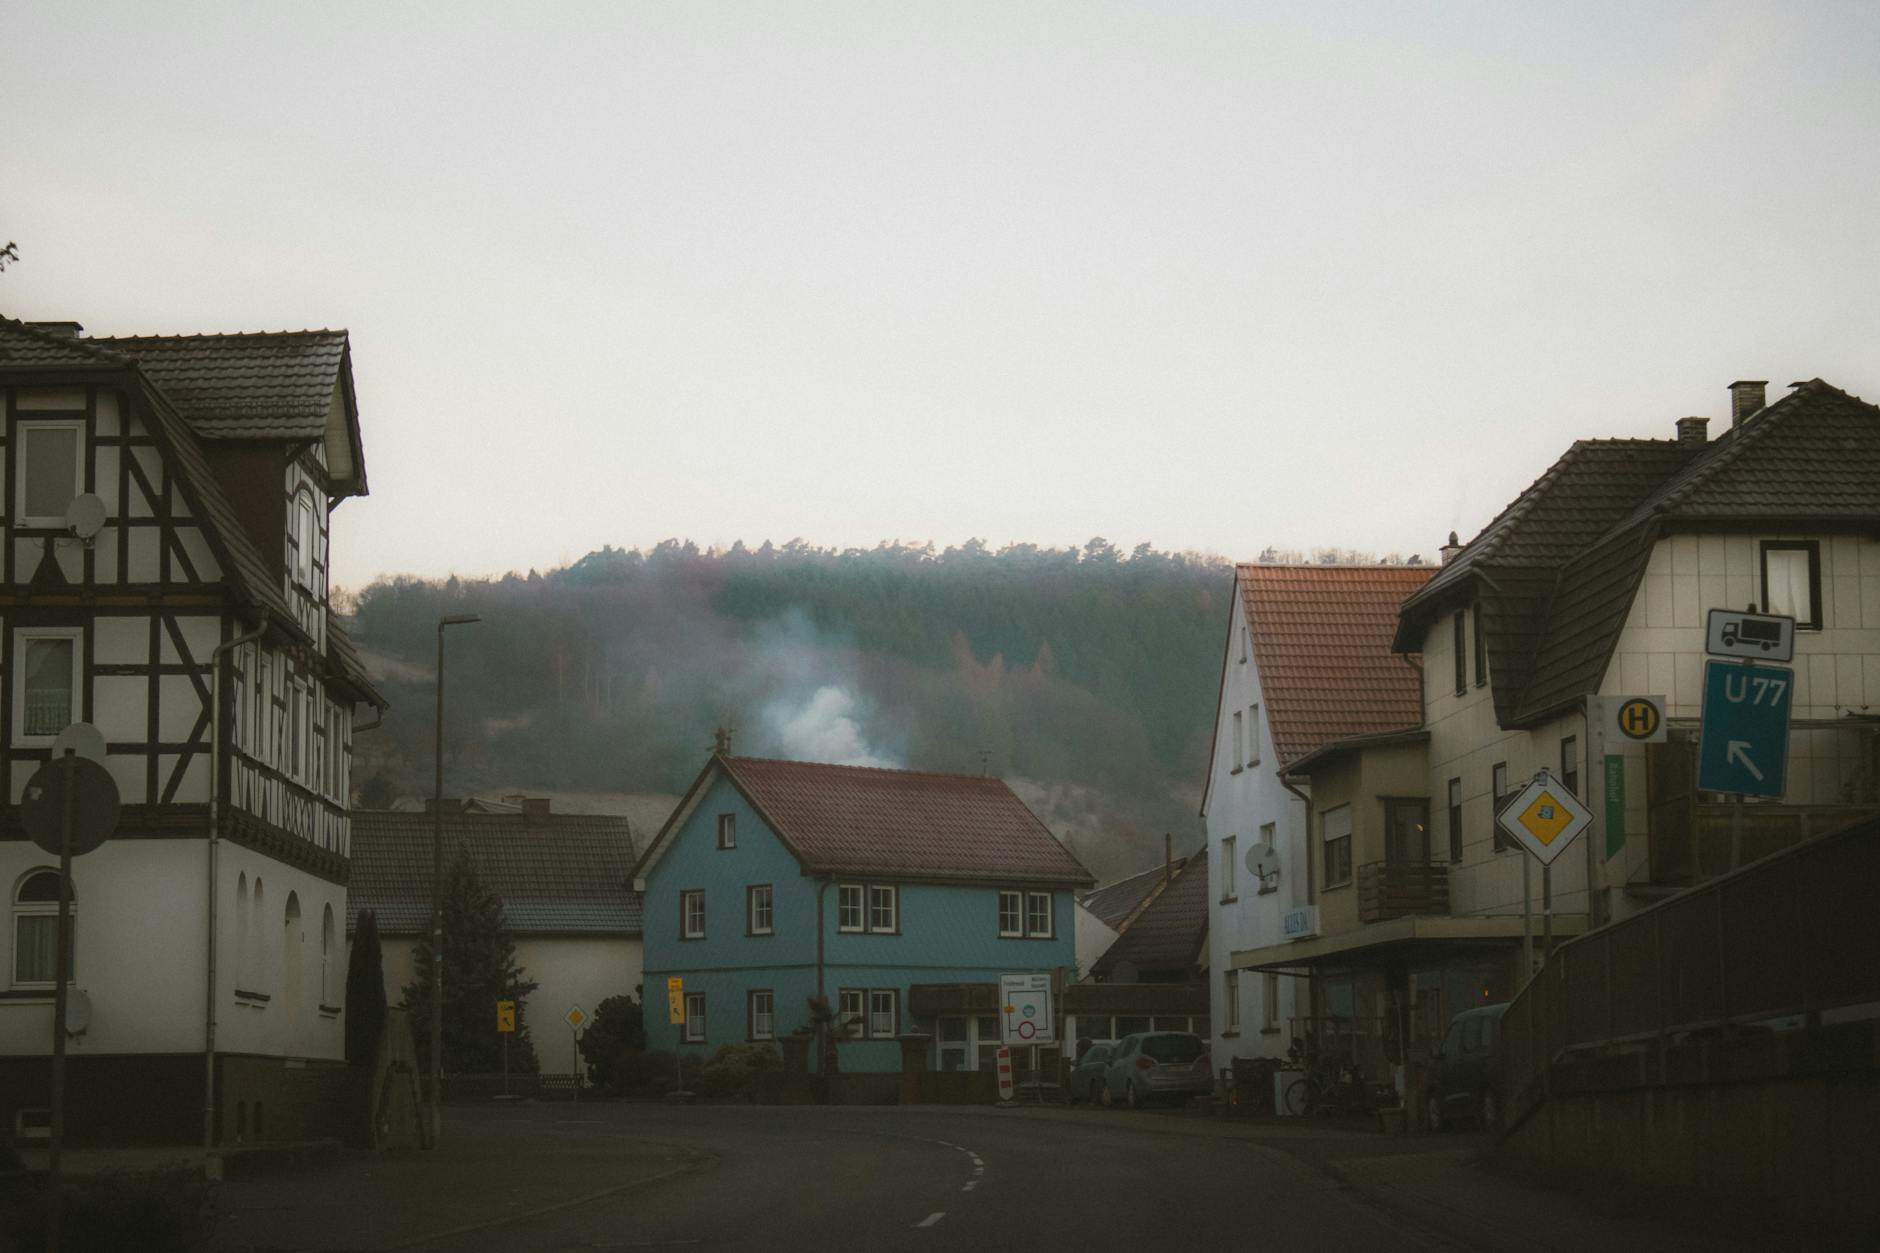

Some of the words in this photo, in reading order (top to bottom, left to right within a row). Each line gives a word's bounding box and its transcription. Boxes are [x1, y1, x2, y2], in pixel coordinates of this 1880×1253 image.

[1726, 673, 1747, 703] U
[1752, 677, 1787, 707] 77
[1628, 707, 1649, 731] H
